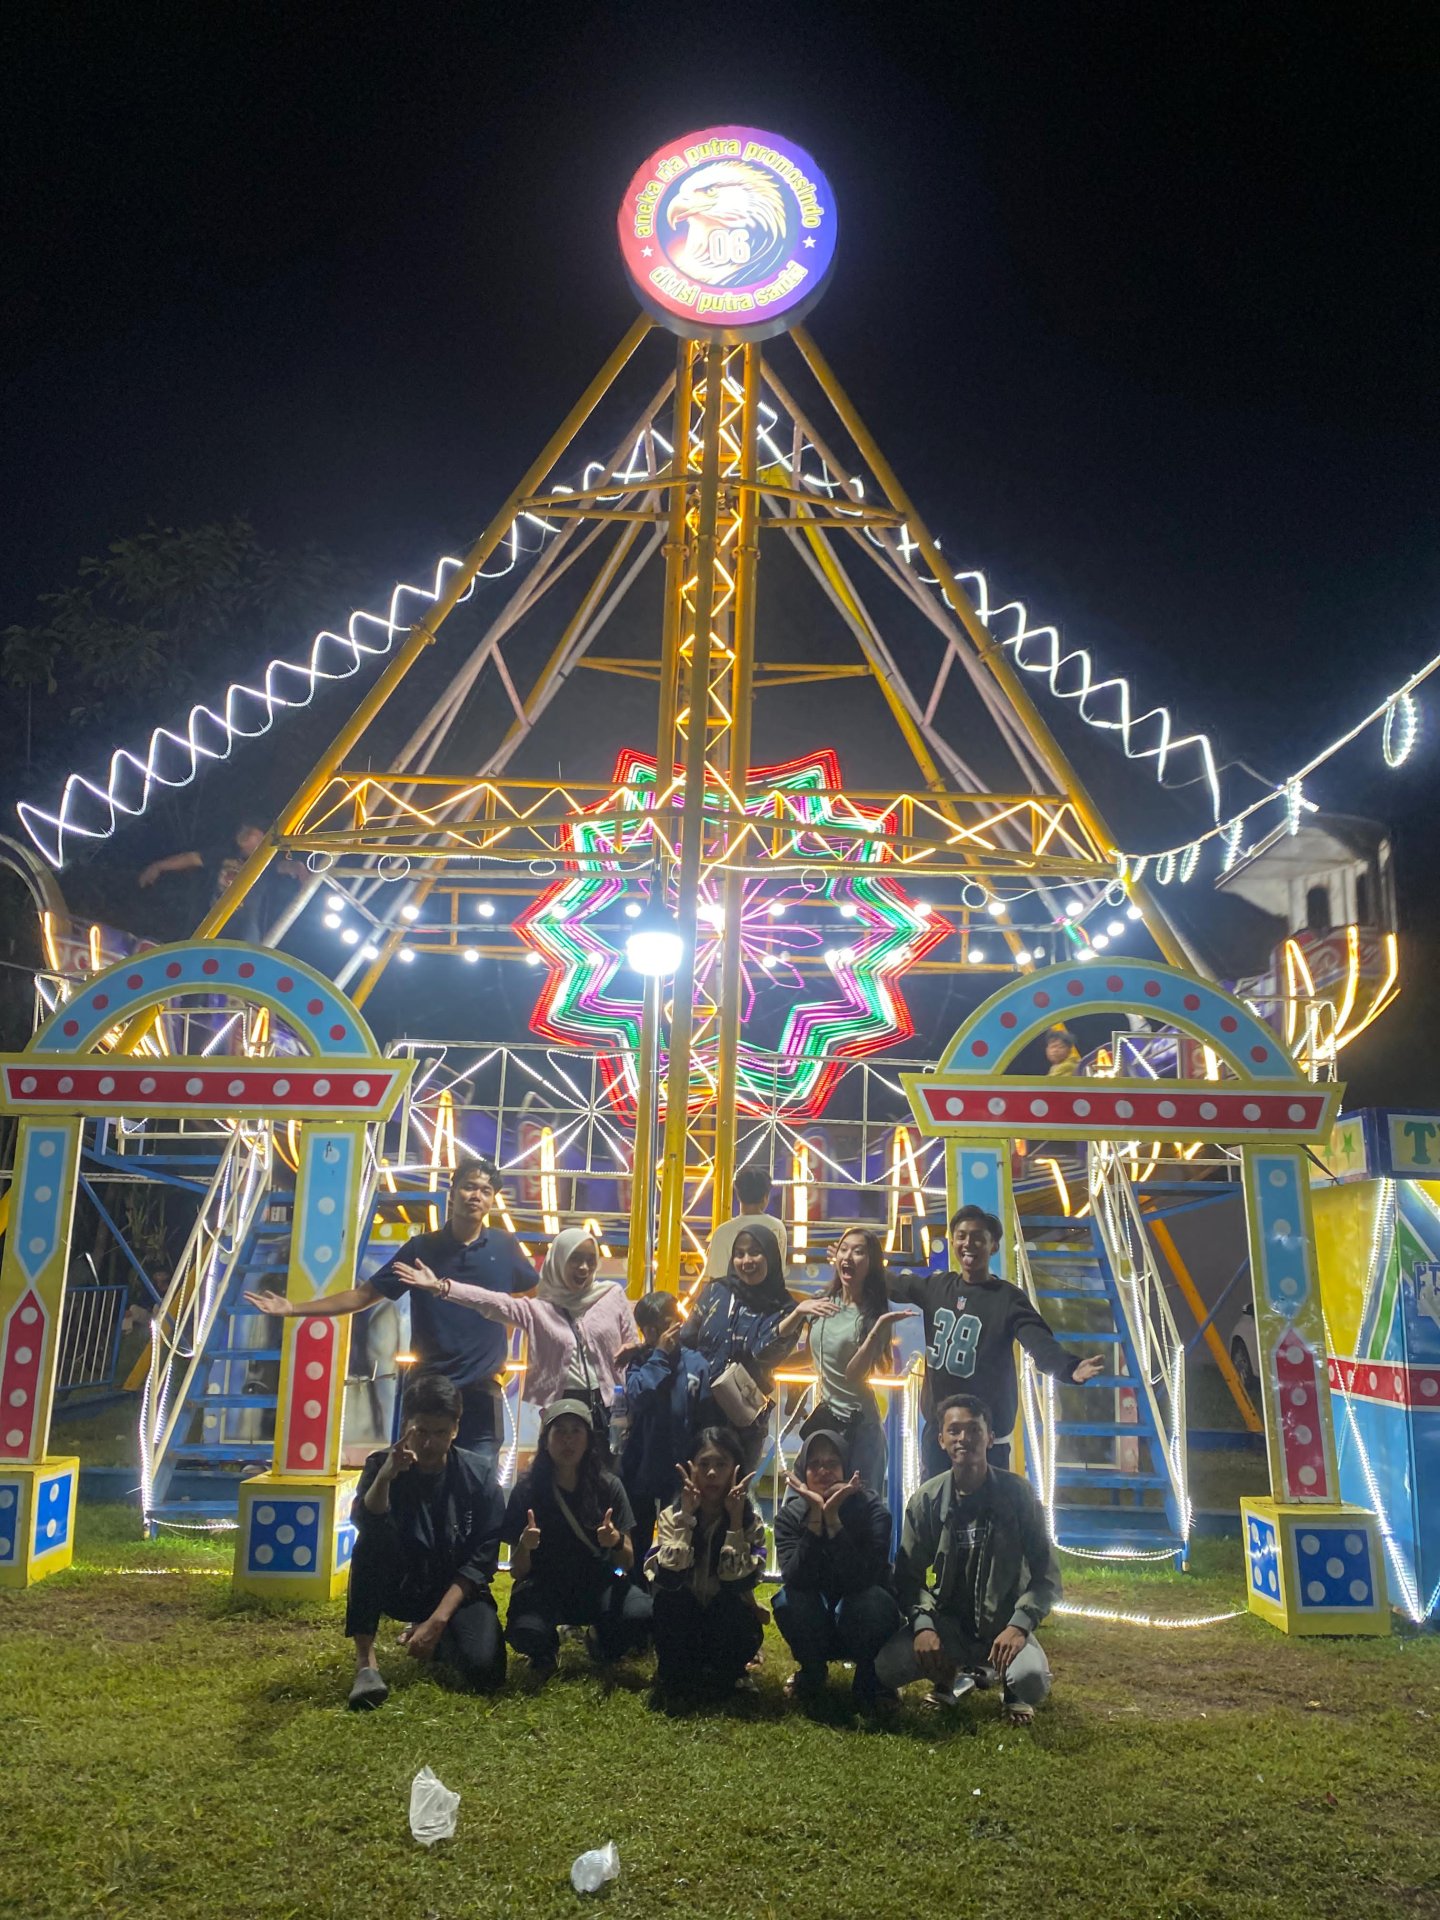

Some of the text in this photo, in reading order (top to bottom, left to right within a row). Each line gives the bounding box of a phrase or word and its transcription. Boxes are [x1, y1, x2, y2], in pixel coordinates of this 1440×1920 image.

[635, 138, 823, 238] aneka ria putra promosindo
[650, 266, 700, 304] divisi
[698, 293, 752, 313] putra
[927, 1307, 982, 1379] 38
